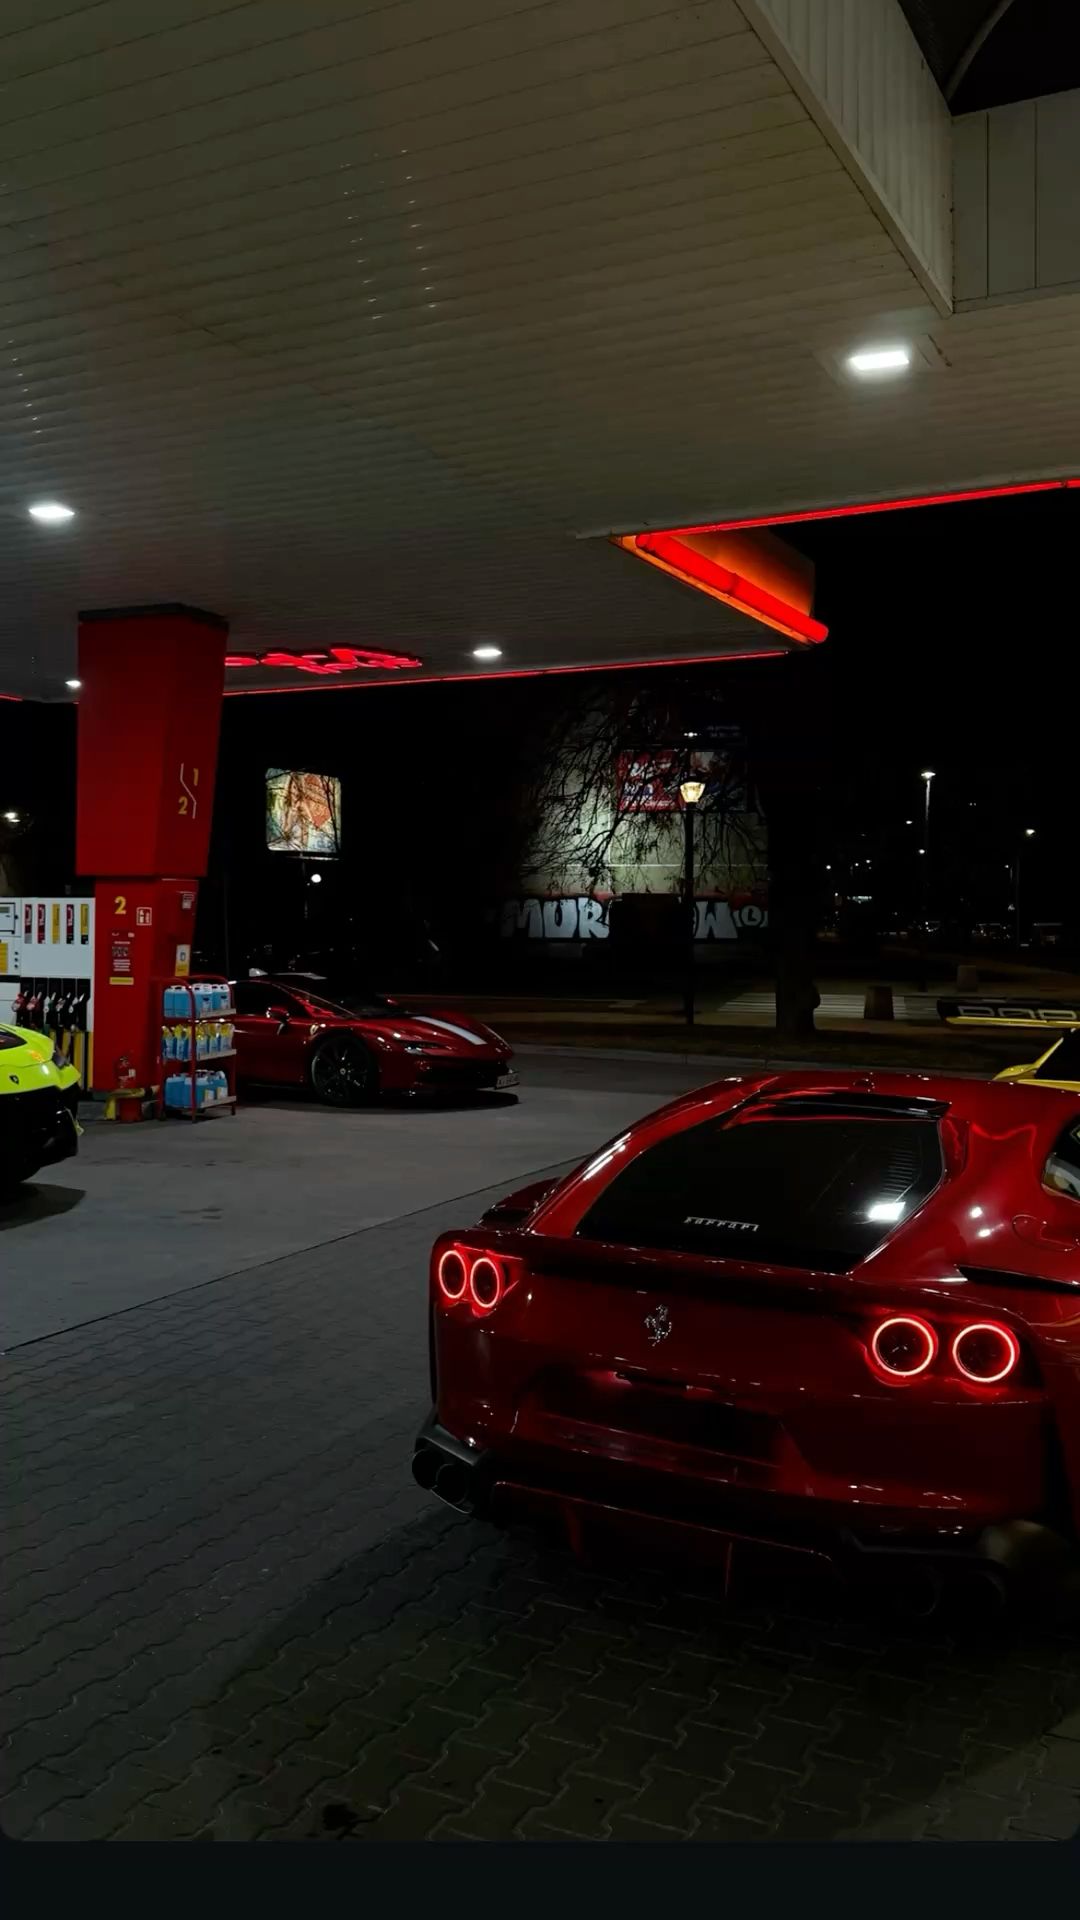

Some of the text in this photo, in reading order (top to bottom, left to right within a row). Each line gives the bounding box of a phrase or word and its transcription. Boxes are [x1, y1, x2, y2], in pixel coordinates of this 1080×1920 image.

[192, 767, 199, 787] 1
[178, 795, 188, 815] 2
[113, 895, 127, 915] 2
